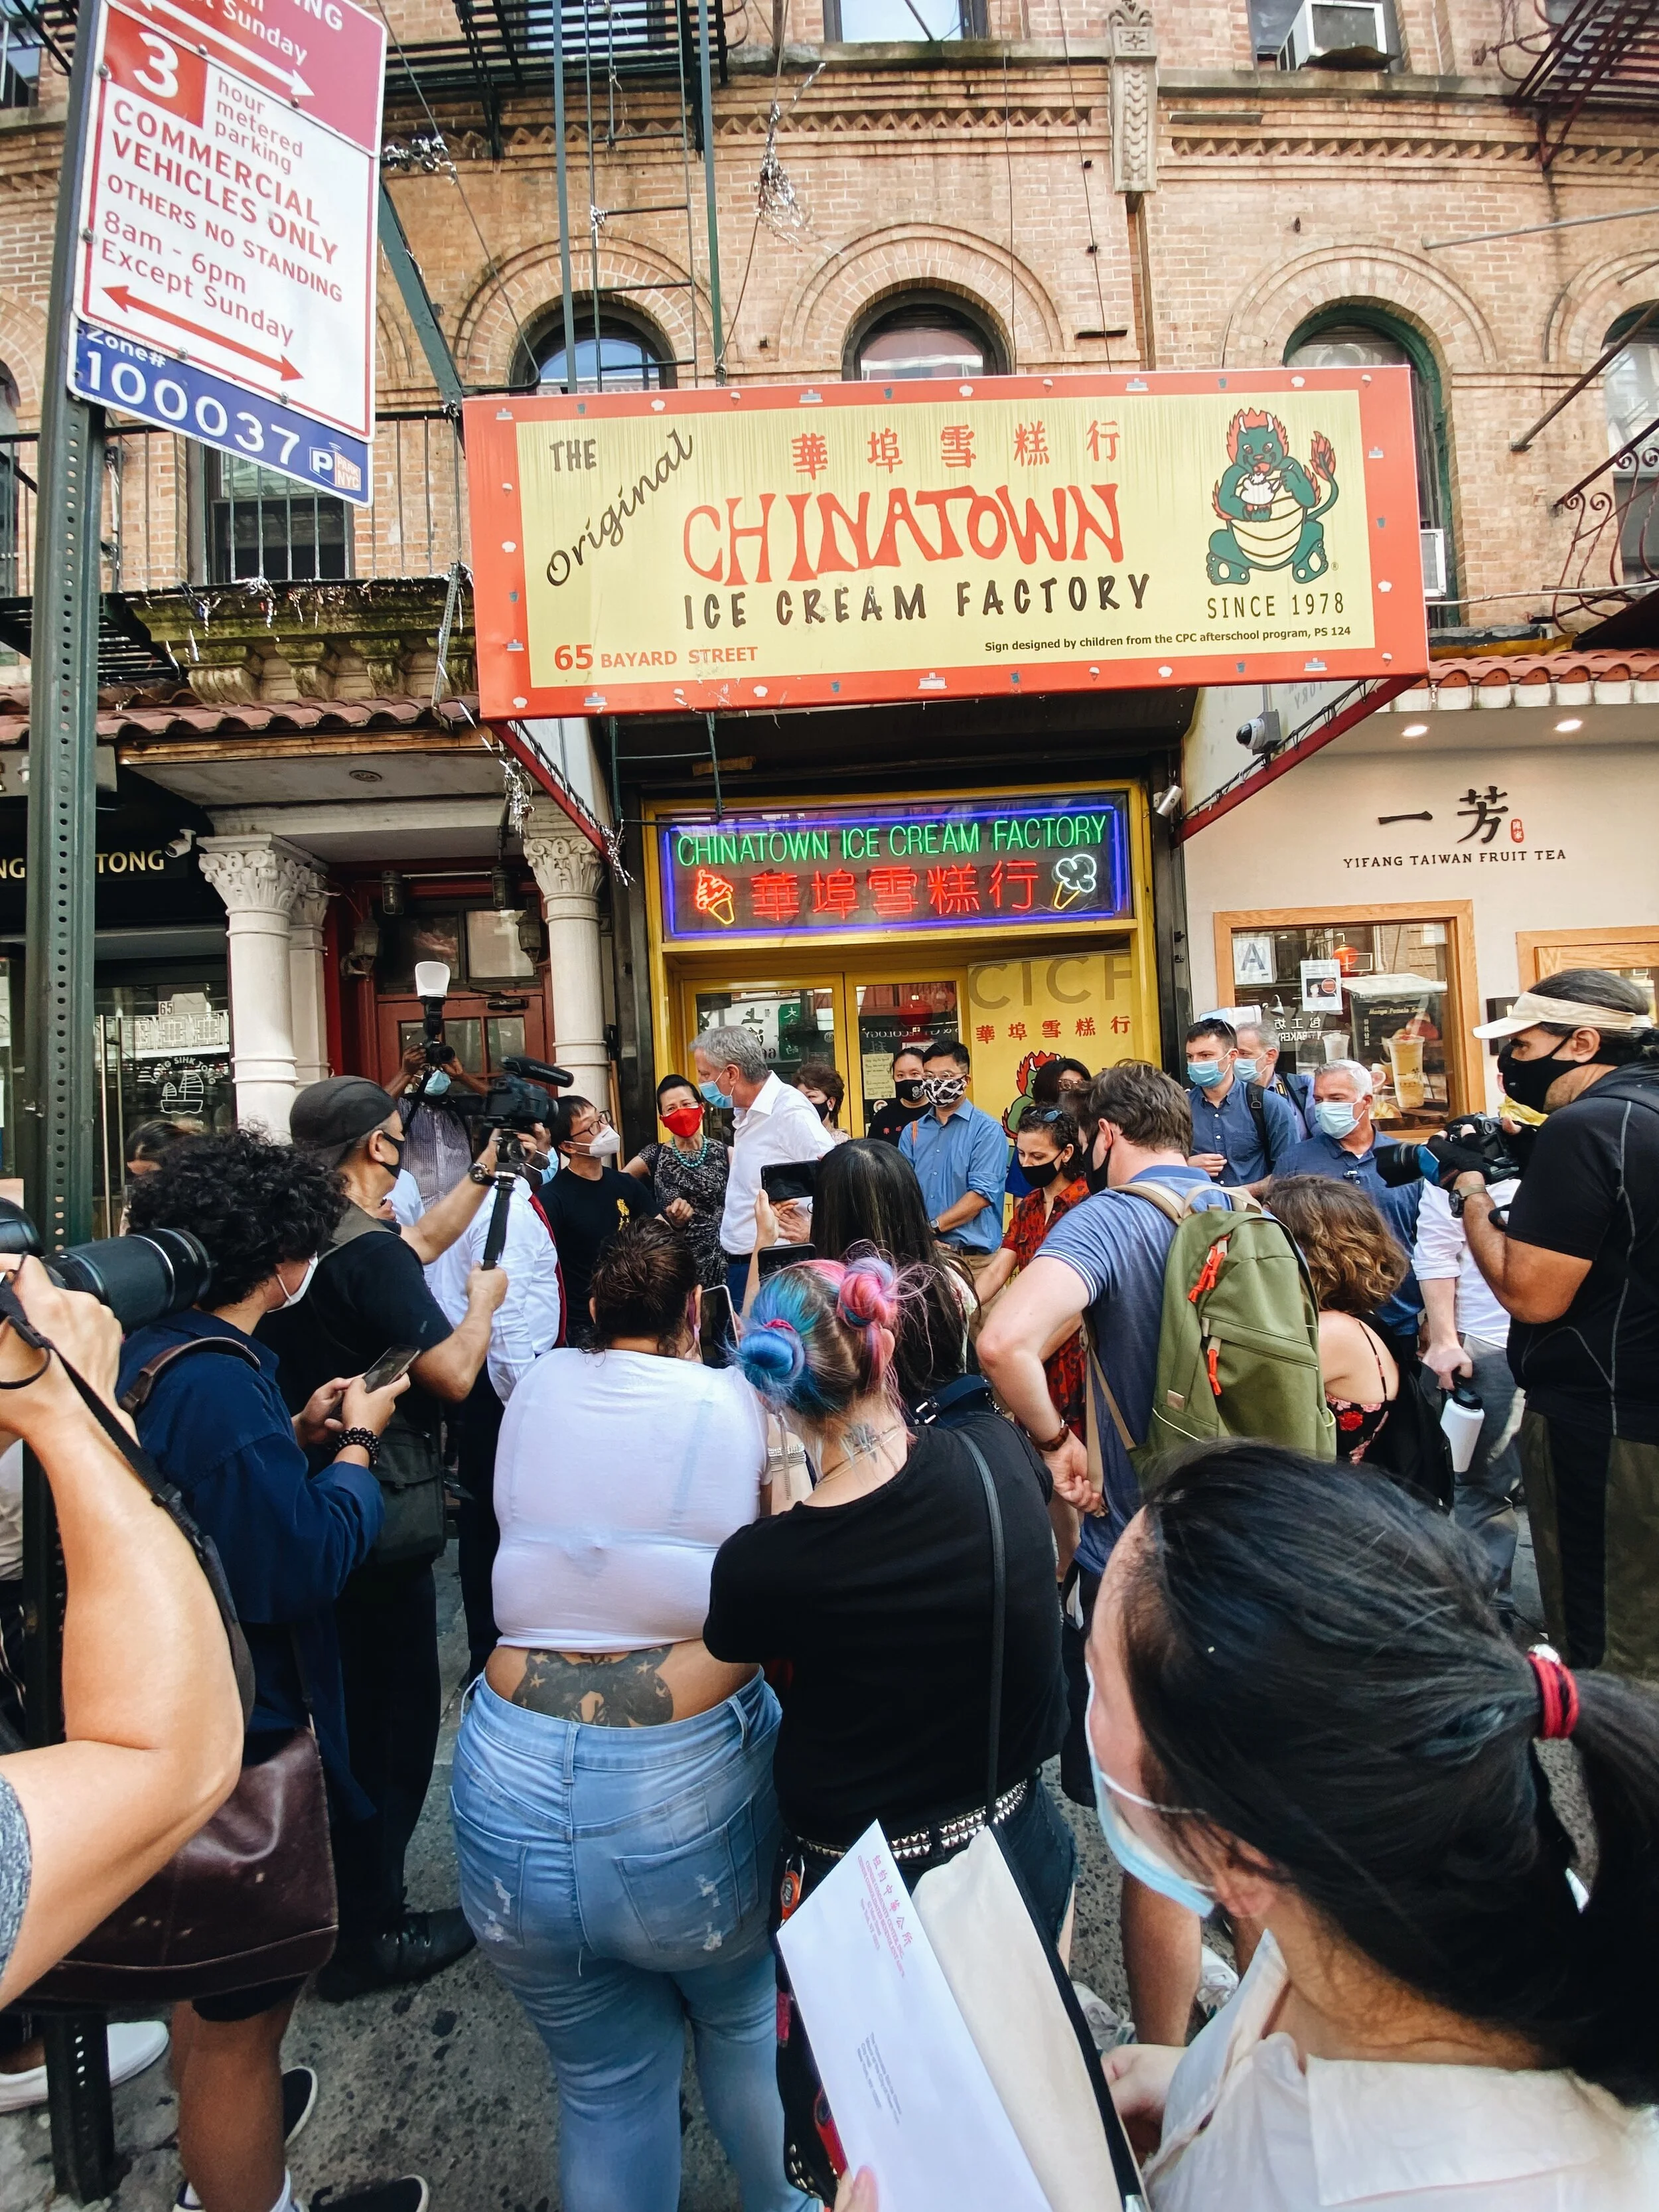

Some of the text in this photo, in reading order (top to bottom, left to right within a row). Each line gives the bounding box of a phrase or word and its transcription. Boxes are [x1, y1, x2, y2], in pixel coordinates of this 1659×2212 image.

[222, 0, 308, 66] Sunday
[133, 32, 179, 99] 3
[218, 76, 265, 115] hour
[214, 119, 292, 175] parking
[216, 100, 303, 159] metered
[113, 99, 320, 226] COMMERCIAL
[111, 129, 338, 265] VEHICLES ONLY
[104, 210, 163, 256] 8am
[191, 252, 246, 294] 6pm
[107, 174, 343, 303] OTHERS NO STANDING
[101, 238, 193, 298] Except
[204, 285, 294, 346] Sunday
[87, 350, 301, 465] 100037
[336, 456, 360, 478] PARK
[549, 438, 598, 473] THE
[791, 419, 1121, 480] 華埠雪糕行
[336, 471, 360, 488] NYC
[545, 427, 693, 587] Original
[683, 483, 1124, 586] CHINATOWN
[684, 573, 1150, 630] ICE CREAM FACTORY
[1207, 592, 1344, 619] SINCE 1978
[554, 644, 758, 670] 65 BAYARD STREET
[985, 626, 1351, 652] Sign designed by children from the CPC afterschool program, PS 124
[677, 815, 1106, 866] CHINATOWN ICE CREAM FACTORY
[1378, 786, 1509, 844] 一芳
[1343, 849, 1566, 869] YIFANG TAIWAN FRUIT TEA
[751, 860, 1039, 921] 華埠雪糕行
[1240, 942, 1265, 971] A
[160, 1001, 173, 1015] 65
[975, 1015, 1131, 1045] 華埠雪糕行
